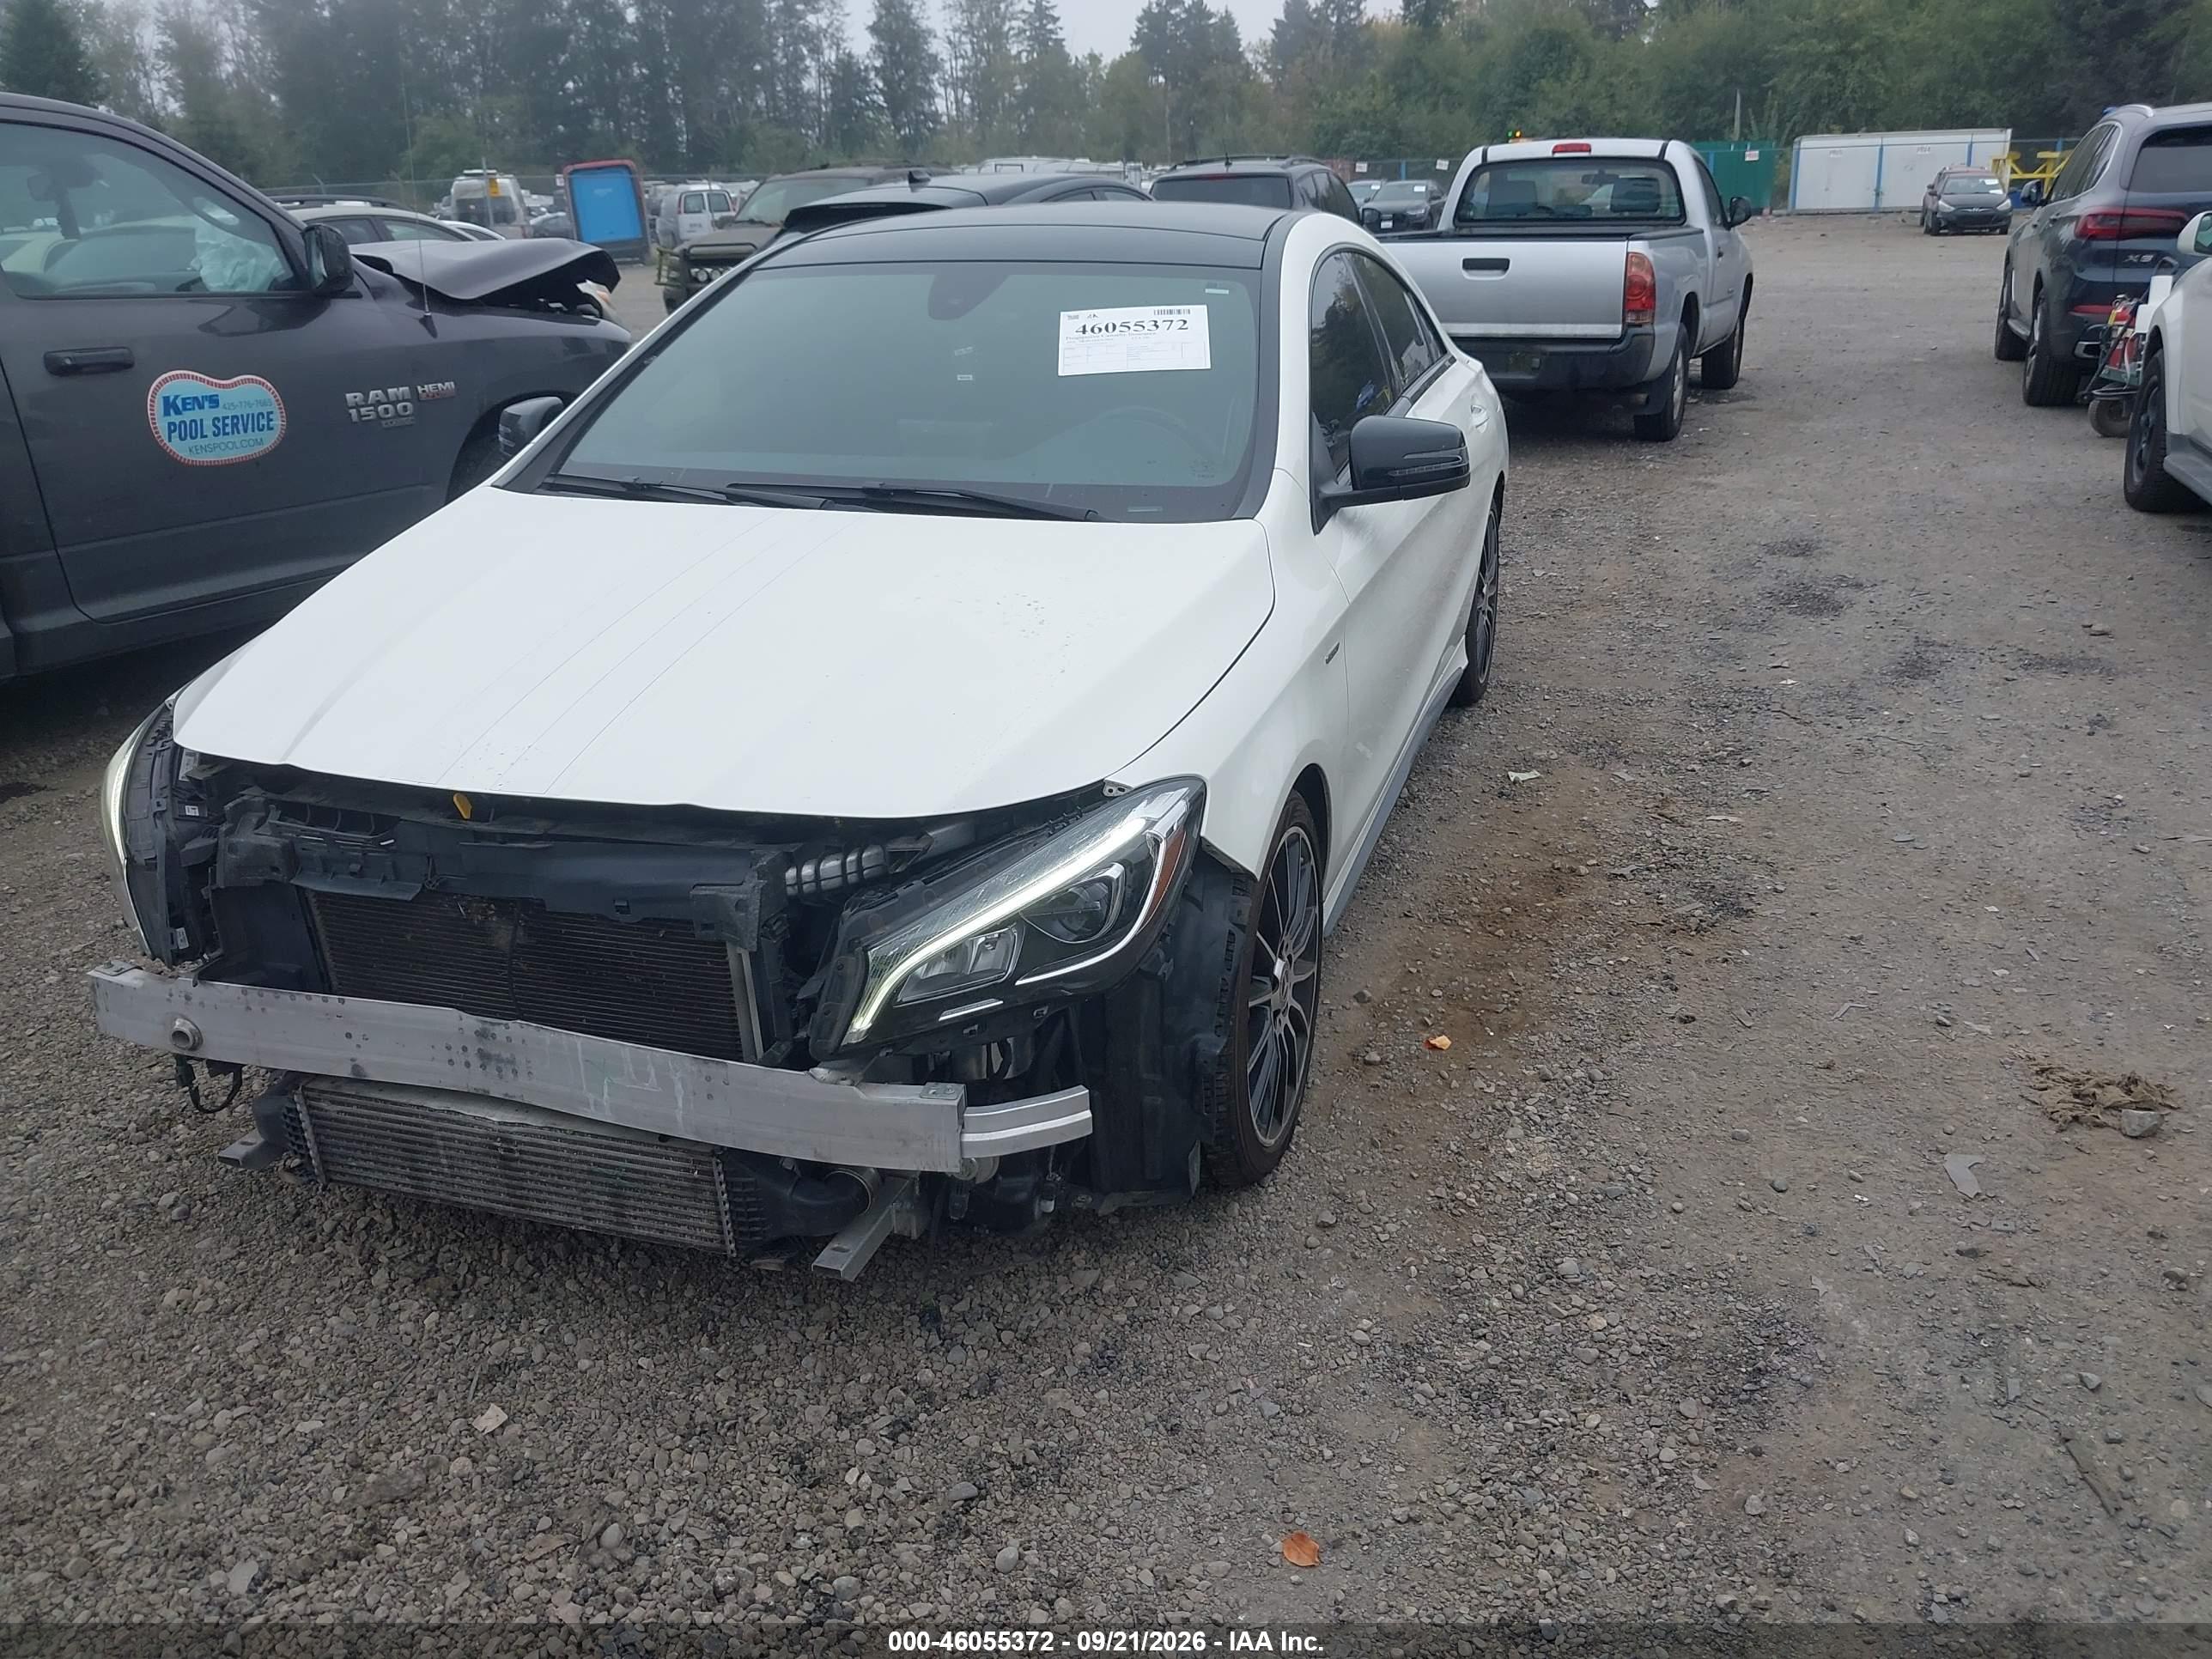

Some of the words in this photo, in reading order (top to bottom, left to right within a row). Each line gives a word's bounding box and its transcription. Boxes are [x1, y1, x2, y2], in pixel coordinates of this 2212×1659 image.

[1074, 319, 1189, 335] 46055372
[345, 386, 411, 407] RAM
[416, 381, 455, 394] HEMI
[349, 402, 414, 422] 1500
[167, 418, 208, 442] POOL
[212, 411, 274, 437] SERVICE
[188, 438, 264, 455] KENSPOOL.COM
